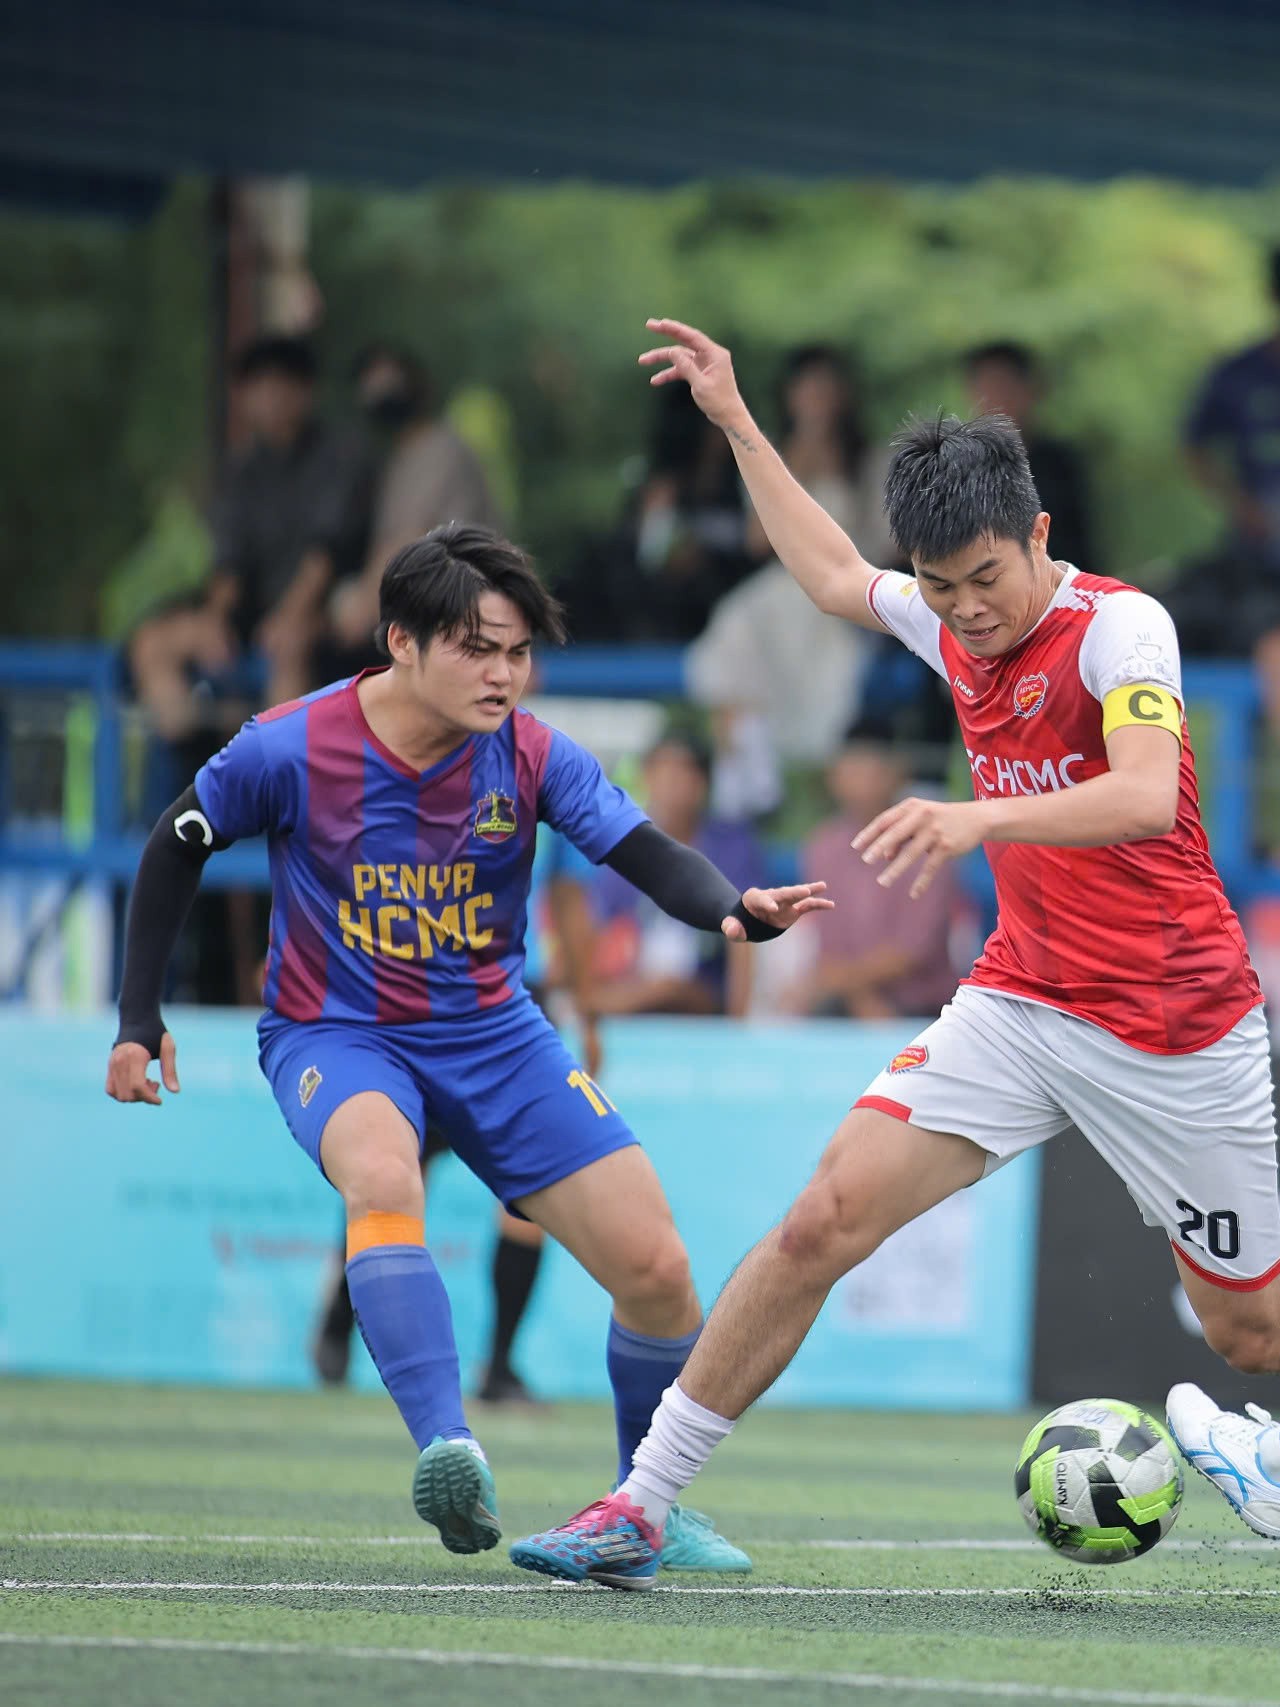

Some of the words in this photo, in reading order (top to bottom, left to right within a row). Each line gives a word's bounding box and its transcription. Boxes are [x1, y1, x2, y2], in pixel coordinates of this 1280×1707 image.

[1128, 690, 1163, 720] C
[994, 753, 1085, 796] HCMC
[352, 863, 476, 901] PENYA
[338, 892, 494, 960] HCMC
[1176, 1198, 1240, 1259] 20
[1055, 1462, 1068, 1505] KAMITO
